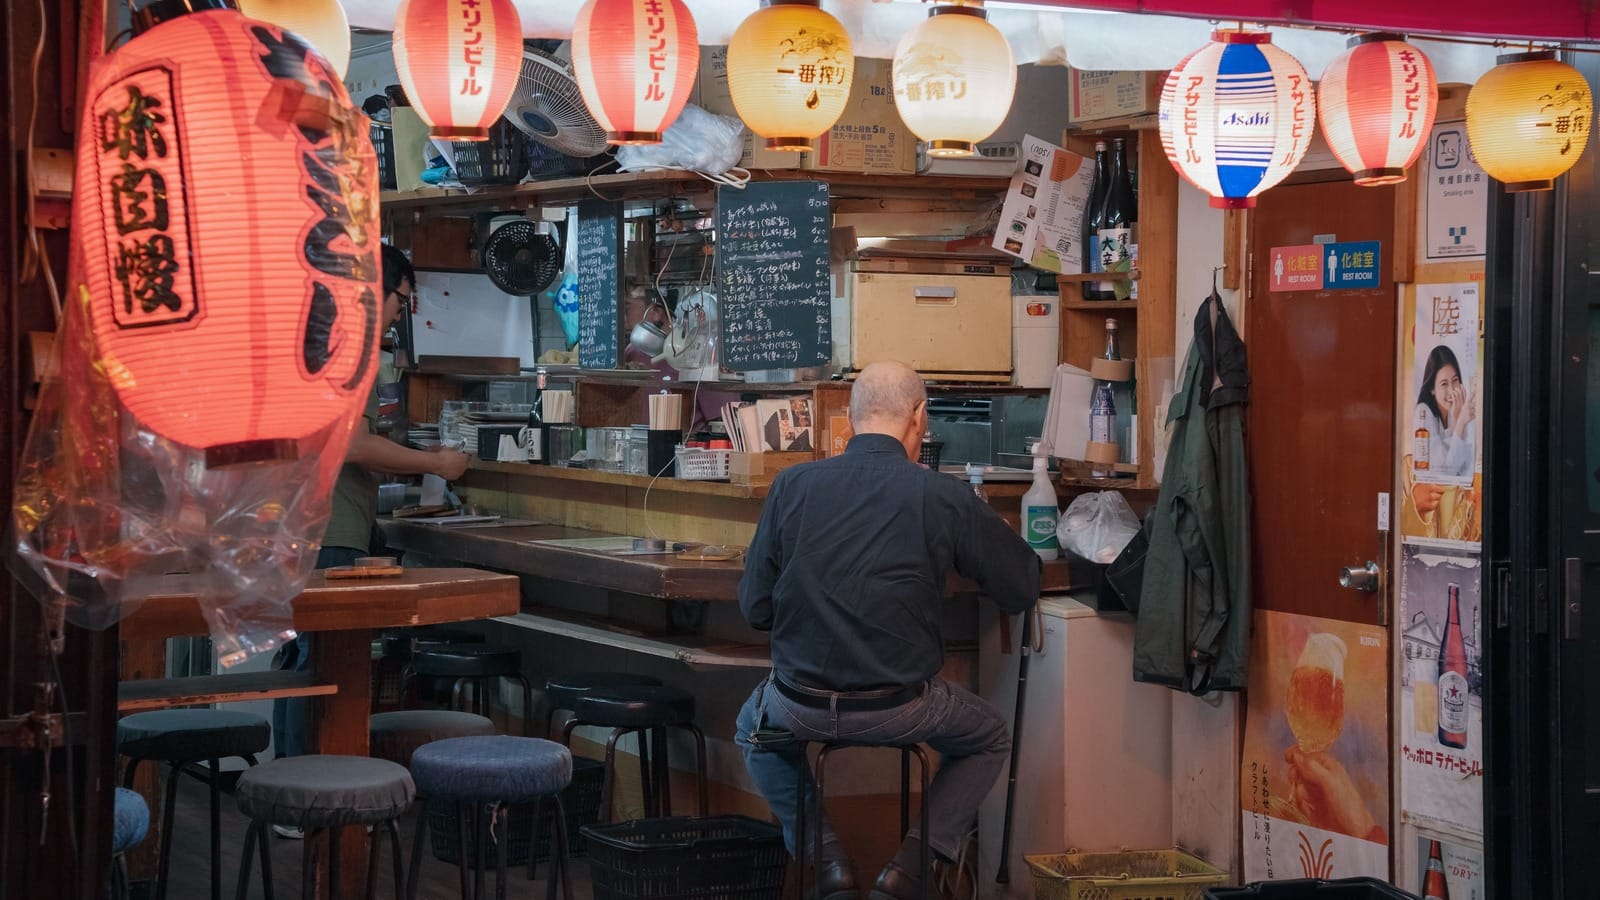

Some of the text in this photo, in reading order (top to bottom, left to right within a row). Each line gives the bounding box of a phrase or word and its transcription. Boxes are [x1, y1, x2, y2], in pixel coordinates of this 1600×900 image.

[776, 63, 846, 85] 一番搾り
[894, 80, 967, 103] 一番搾り
[1398, 49, 1421, 140] キリンビール
[1184, 75, 1203, 165] アサヒビール
[1223, 111, 1271, 127] Asahi
[1279, 74, 1305, 168] アサヒビール
[1101, 235, 1115, 272] 大辛
[1287, 255, 1319, 273] 化粧室
[1341, 250, 1375, 269] 化粧室
[1288, 273, 1317, 283] REST ROOM
[1342, 271, 1373, 281] REST ROOM
[1431, 295, 1460, 336] 陸
[1251, 761, 1261, 841] クラフトビール
